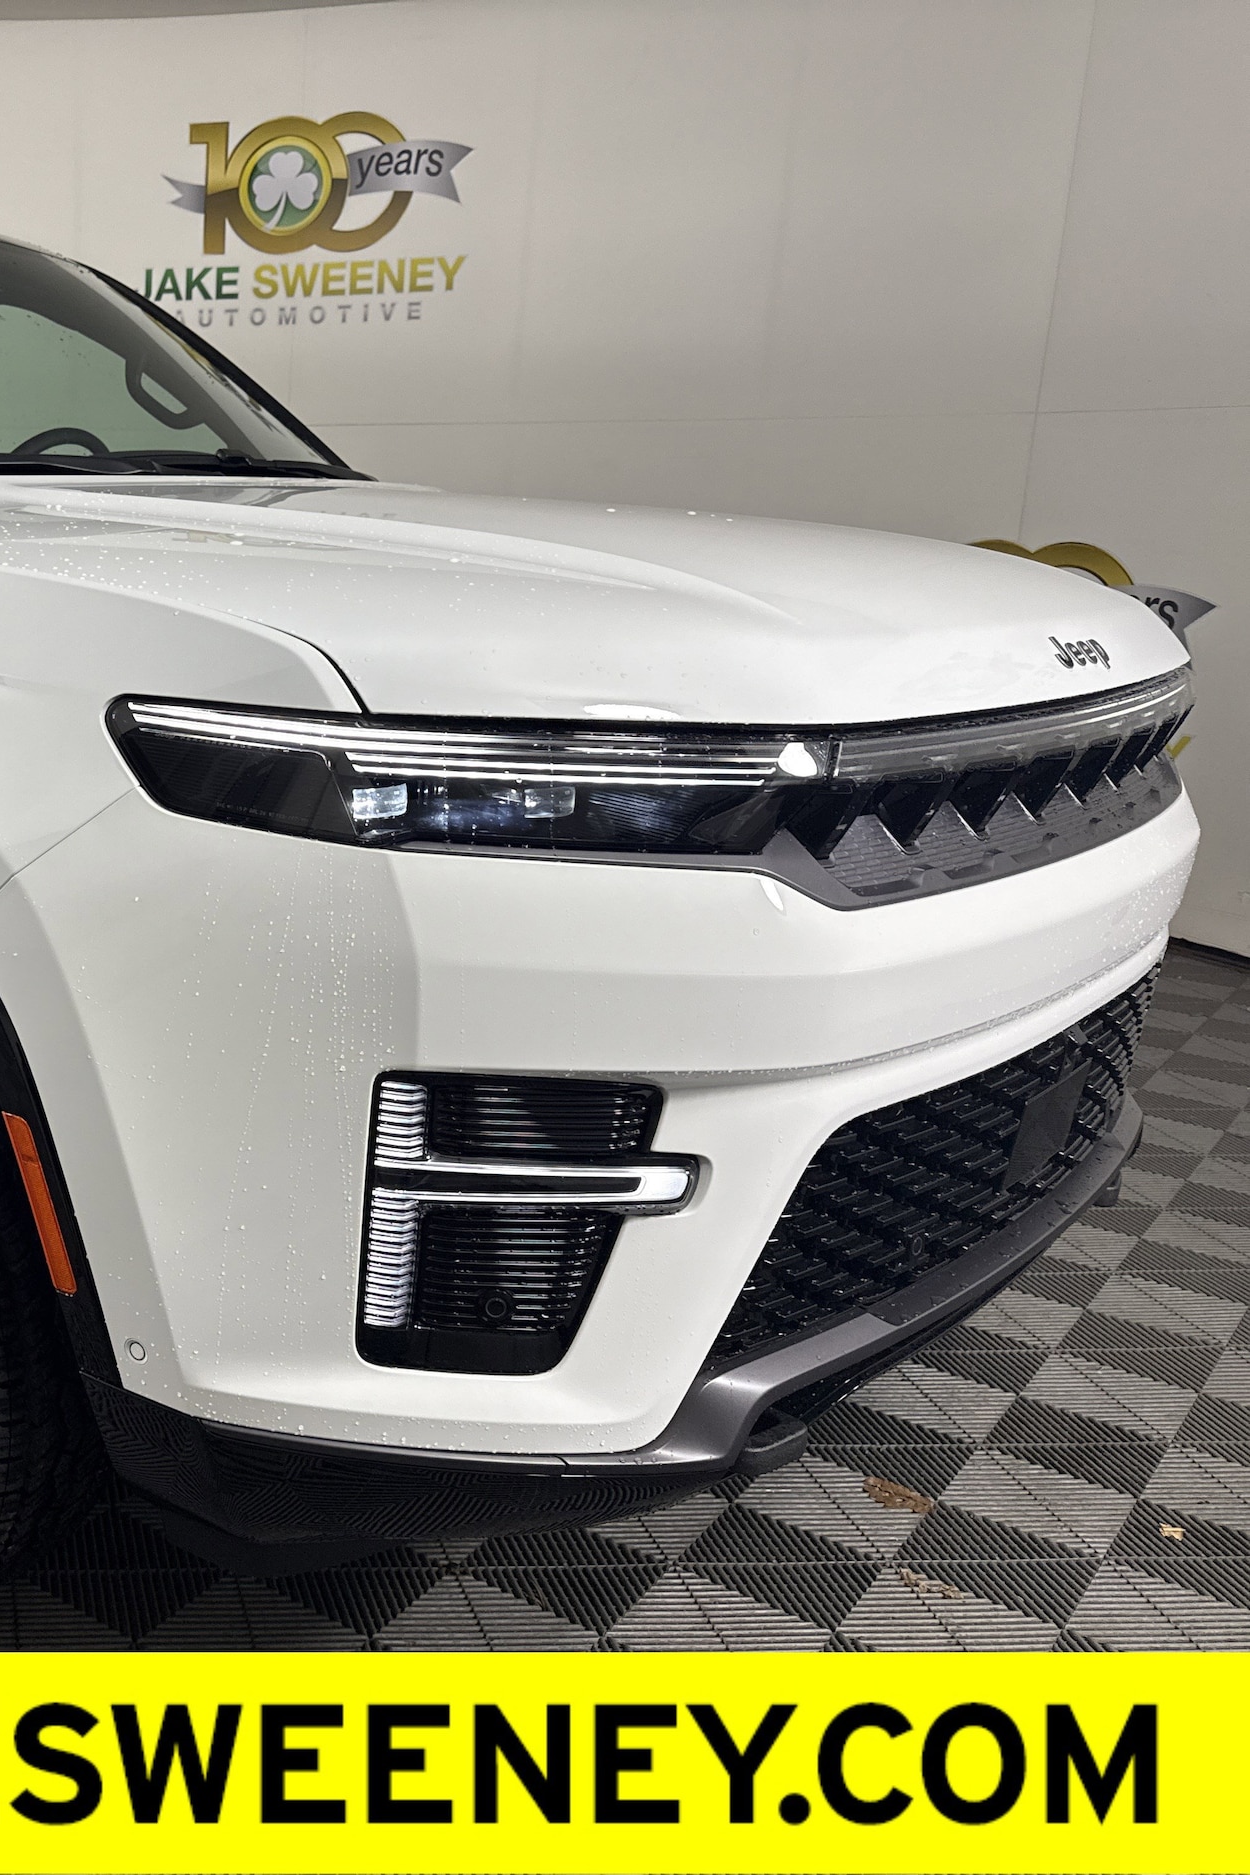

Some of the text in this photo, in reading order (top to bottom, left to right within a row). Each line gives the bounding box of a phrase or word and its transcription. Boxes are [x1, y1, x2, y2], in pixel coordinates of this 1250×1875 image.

[189, 110, 415, 255] 100
[354, 146, 444, 189] years
[137, 255, 467, 301] JAKE SWEENEY
[1048, 635, 1111, 670] Jeep
